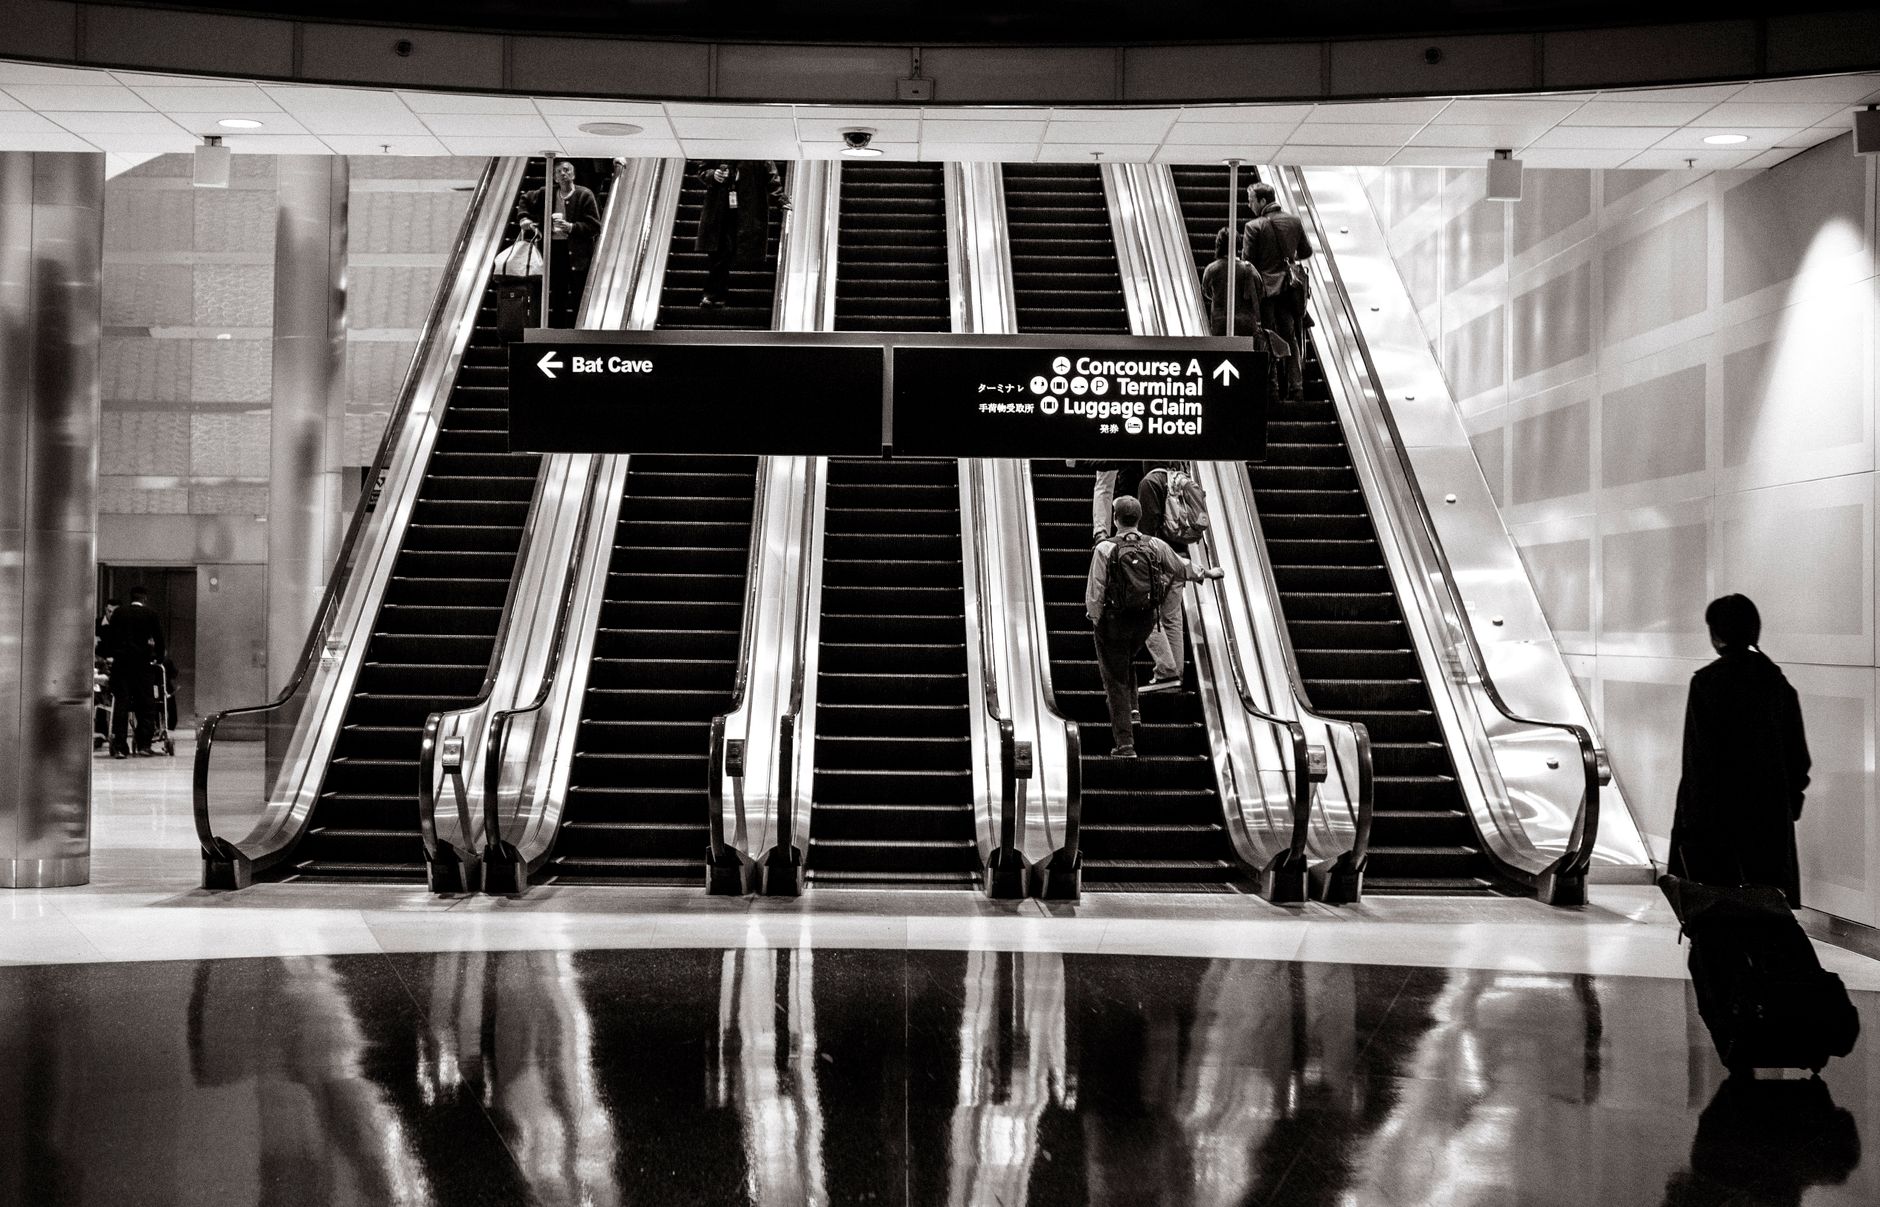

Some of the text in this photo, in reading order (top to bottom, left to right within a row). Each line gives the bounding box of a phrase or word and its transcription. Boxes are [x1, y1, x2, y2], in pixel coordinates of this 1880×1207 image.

[572, 356, 654, 373] Bat Cave
[1076, 357, 1203, 376] Concourse A
[1117, 377, 1204, 396] Terminal
[1064, 397, 1203, 419] Luggage Claim
[1148, 417, 1203, 435] Hotel
